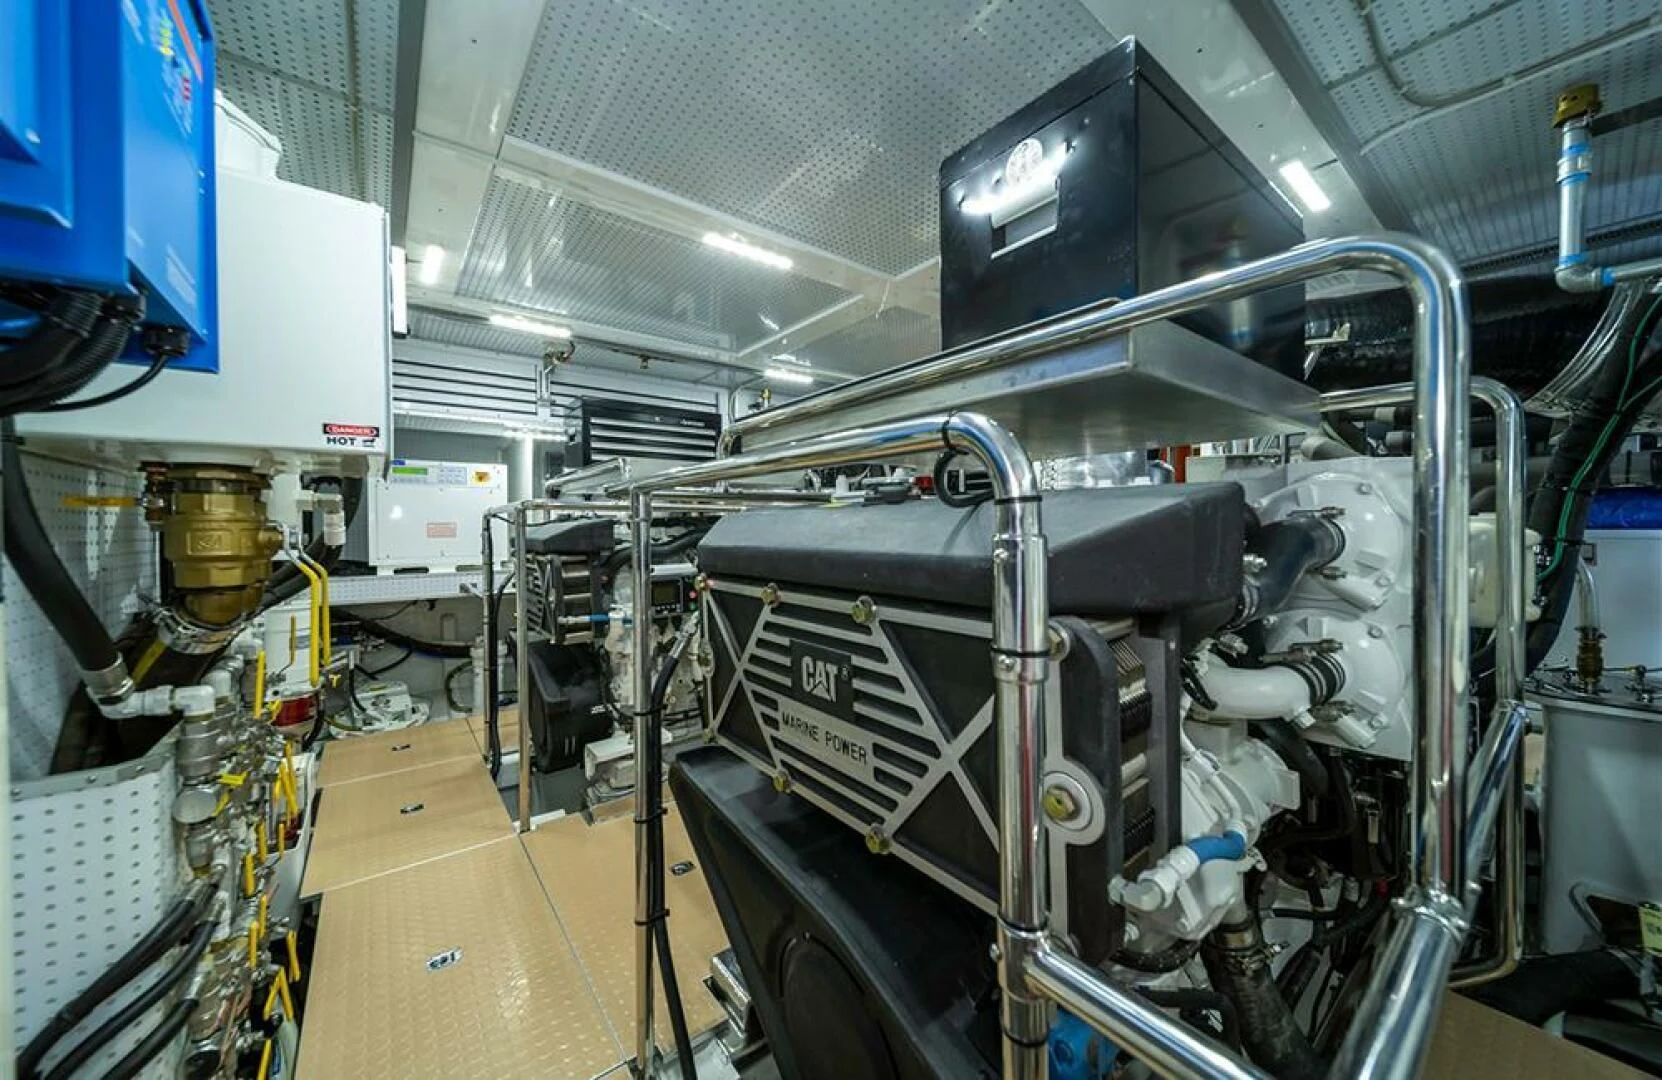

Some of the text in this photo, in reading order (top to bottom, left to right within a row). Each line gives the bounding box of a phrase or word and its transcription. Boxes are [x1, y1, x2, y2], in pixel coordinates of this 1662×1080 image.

[327, 437, 357, 445] HOT
[802, 655, 838, 703] CAT
[782, 711, 867, 766] MARINE POWER
